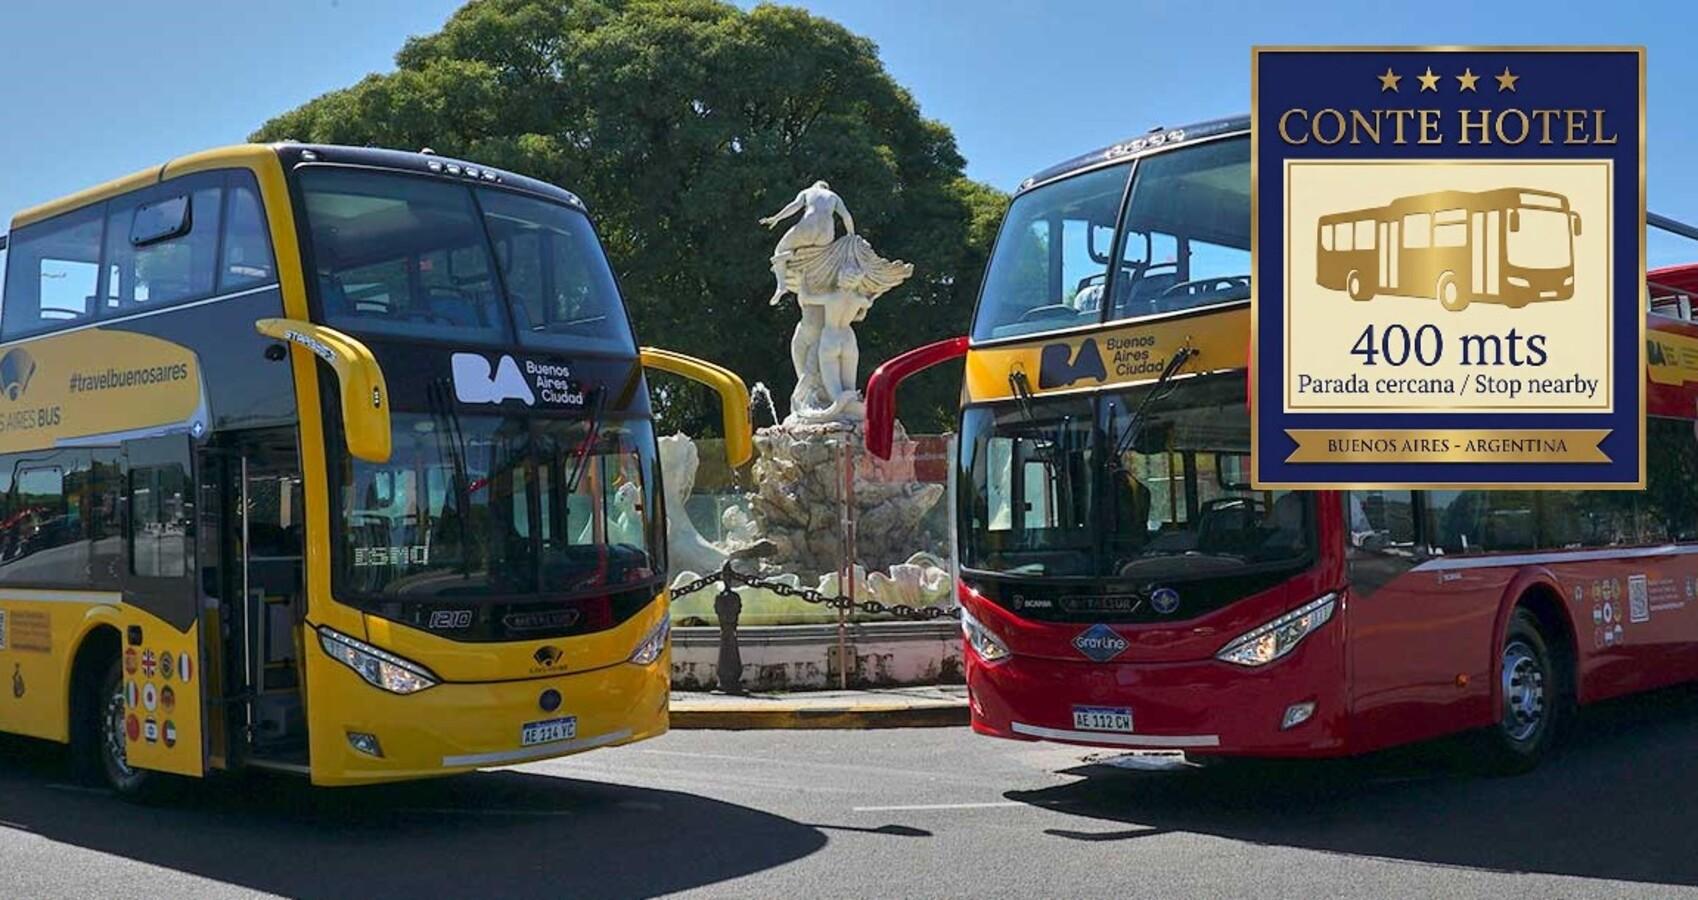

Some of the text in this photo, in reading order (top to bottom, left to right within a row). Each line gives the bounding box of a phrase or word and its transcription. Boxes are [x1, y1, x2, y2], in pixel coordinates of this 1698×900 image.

[1106, 336, 1155, 350] Buenos
[1113, 350, 1149, 363] Aires
[526, 360, 570, 377] Buenos
[1115, 359, 1165, 376] Ciudad
[69, 363, 188, 392] #travelbuenosaires
[536, 376, 569, 390] Aires
[541, 389, 584, 405] Ciudad
[38, 406, 61, 428] BUS
[1024, 600, 1052, 608] SCANIA
[429, 610, 472, 628] 1210
[1077, 714, 1090, 727] AE
[1093, 715, 1113, 728] 112
[525, 729, 537, 744] AE
